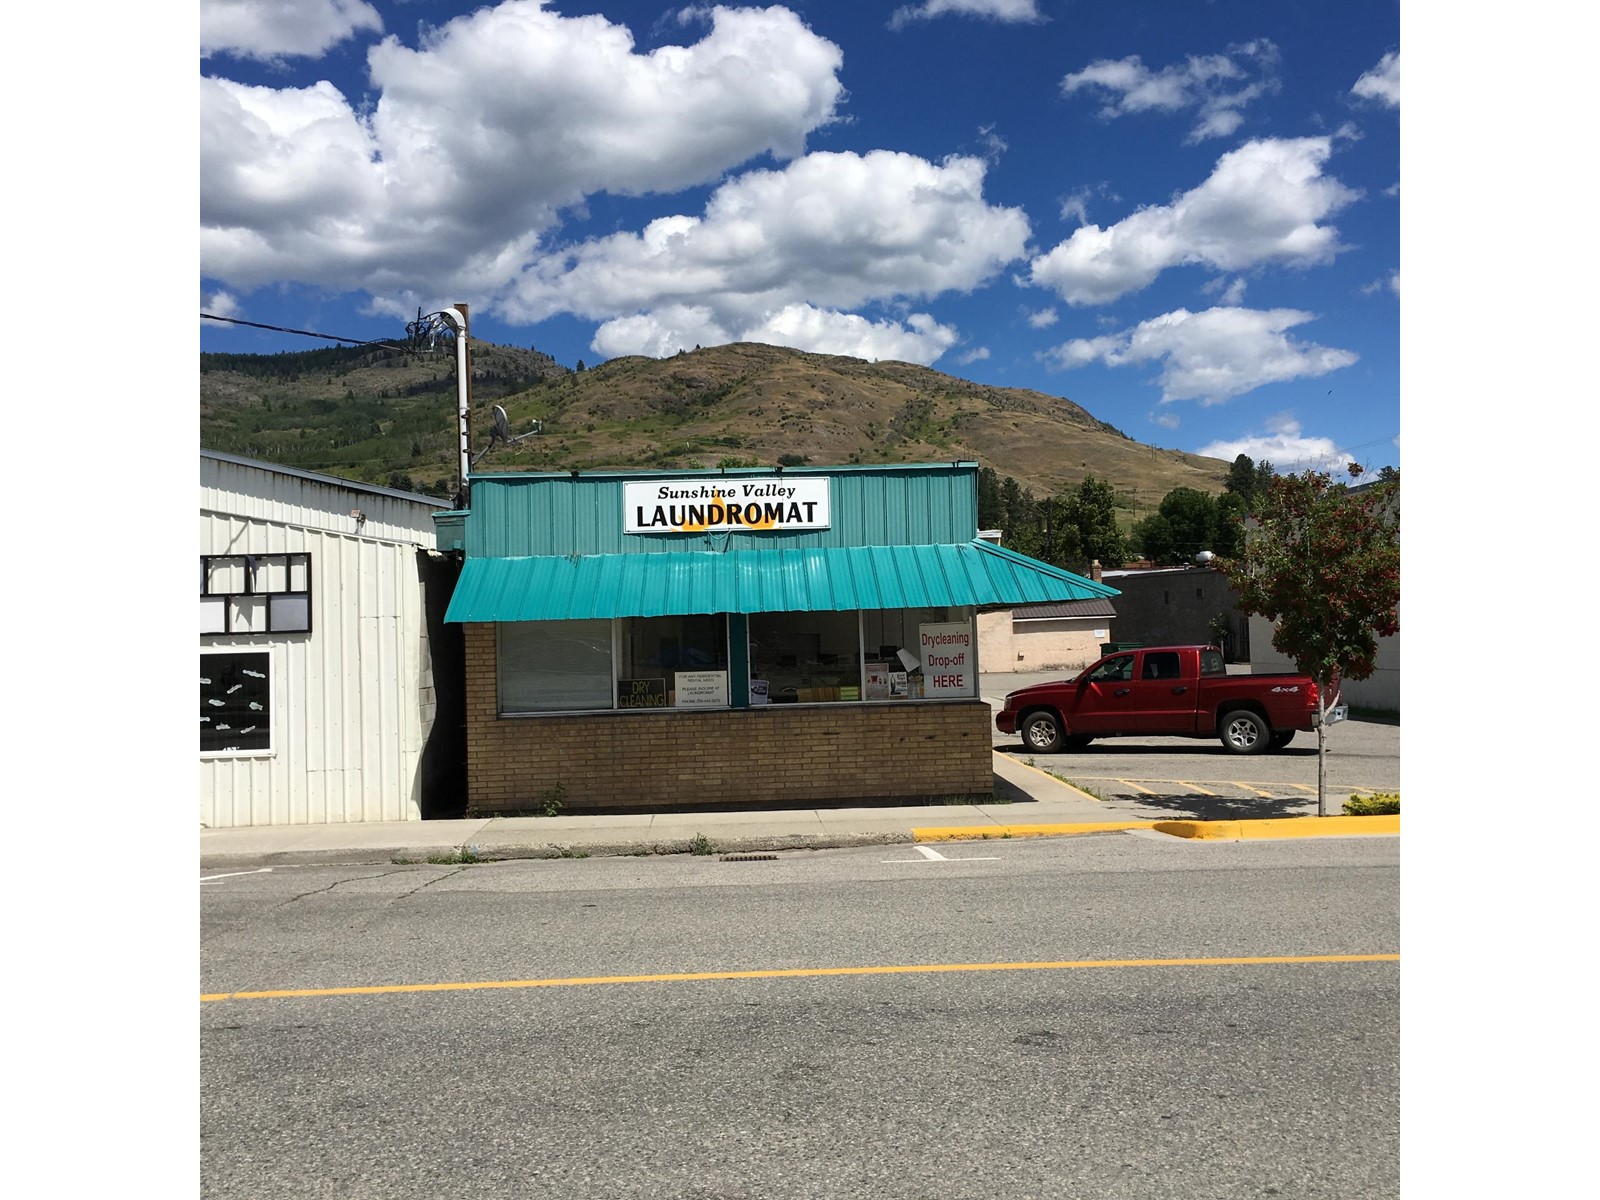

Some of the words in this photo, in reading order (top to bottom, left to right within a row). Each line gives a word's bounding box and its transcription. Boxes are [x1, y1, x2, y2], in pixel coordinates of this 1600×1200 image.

[657, 485, 736, 500] Sunshine
[742, 484, 796, 499] Valley
[636, 501, 818, 527] LAUNDROMAT
[921, 632, 970, 648] Drycleaning
[928, 653, 965, 668] Drop-off
[632, 681, 650, 695] DRY
[933, 674, 964, 688] HERE
[619, 693, 664, 708] CLEANING
